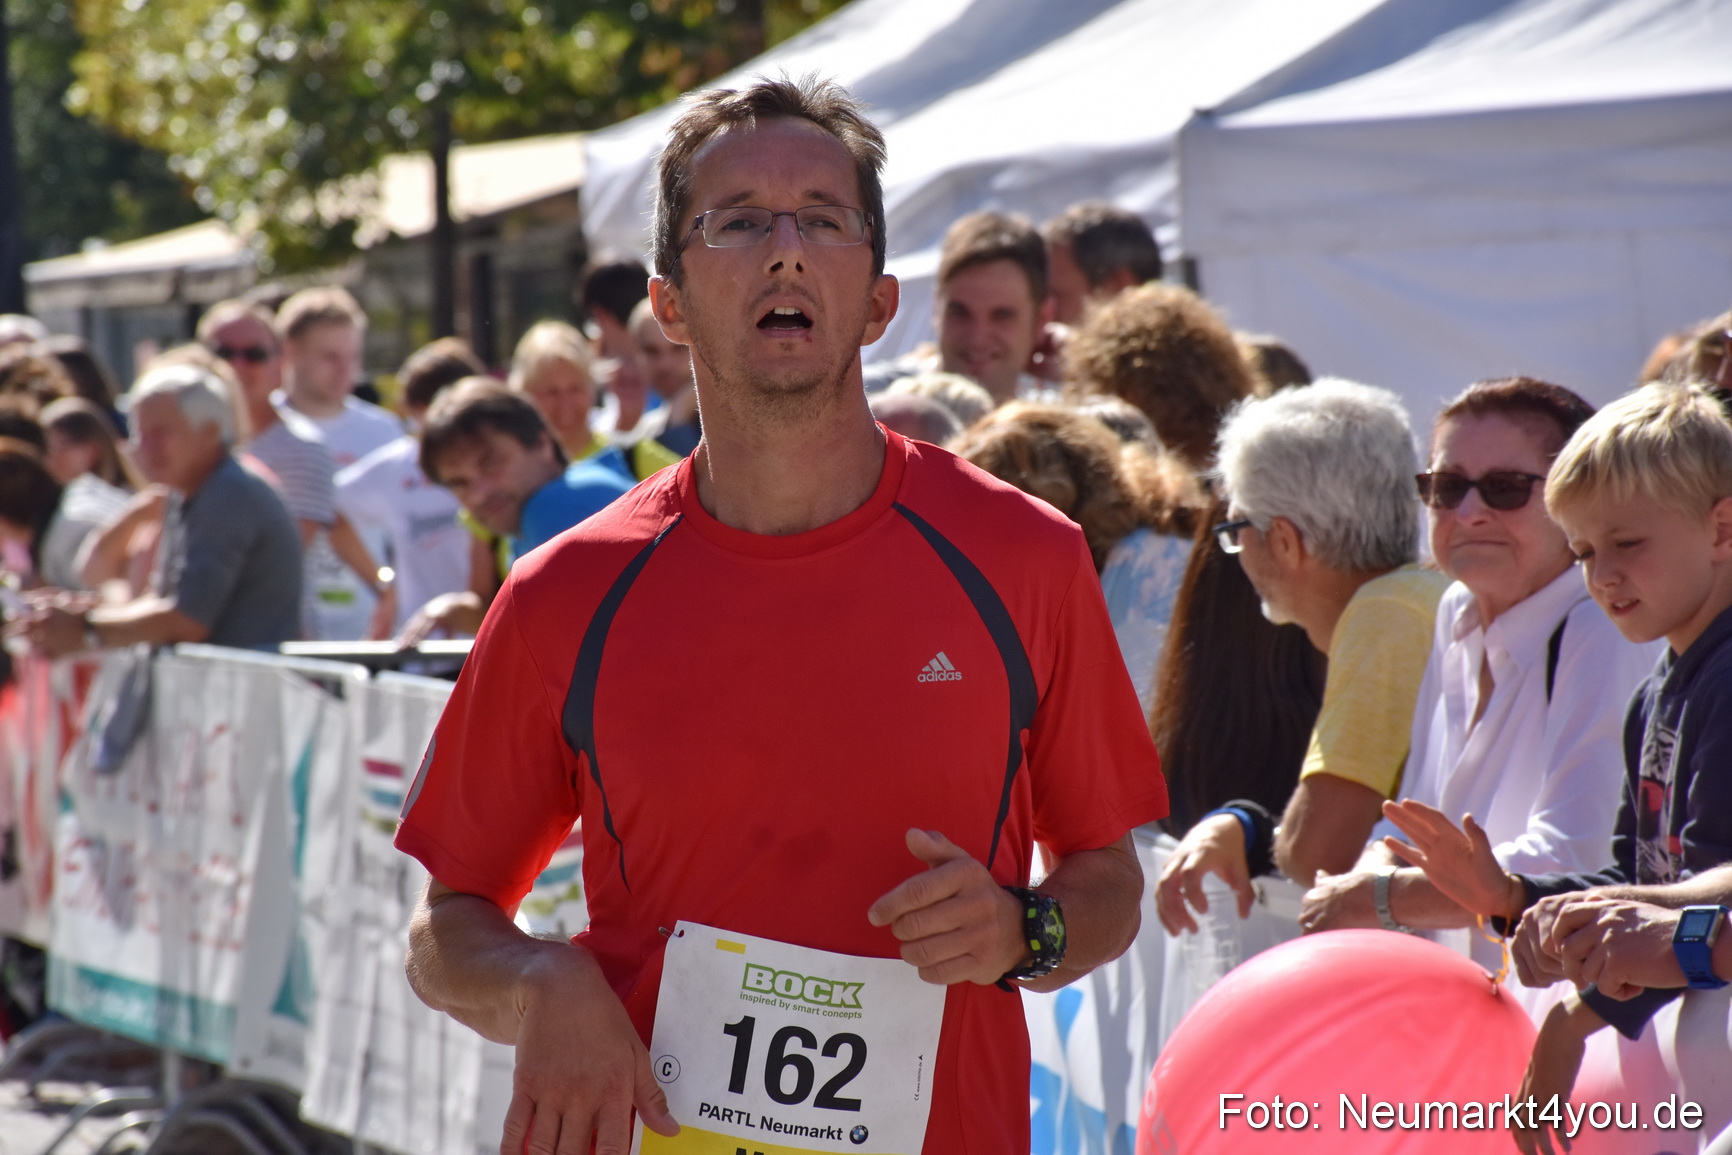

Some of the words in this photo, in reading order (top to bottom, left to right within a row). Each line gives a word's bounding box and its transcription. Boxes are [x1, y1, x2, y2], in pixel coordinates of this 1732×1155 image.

[917, 669, 962, 682] adidas
[742, 963, 865, 1009] BOCK
[740, 991, 777, 1006] inspired
[779, 1001, 791, 1011] by
[792, 1004, 820, 1016] smart
[822, 1009, 862, 1020] concepts
[662, 1061, 672, 1077] C
[723, 1015, 868, 1112] 162
[698, 1102, 756, 1128] PARTL
[759, 1116, 843, 1141] Neumarkt
